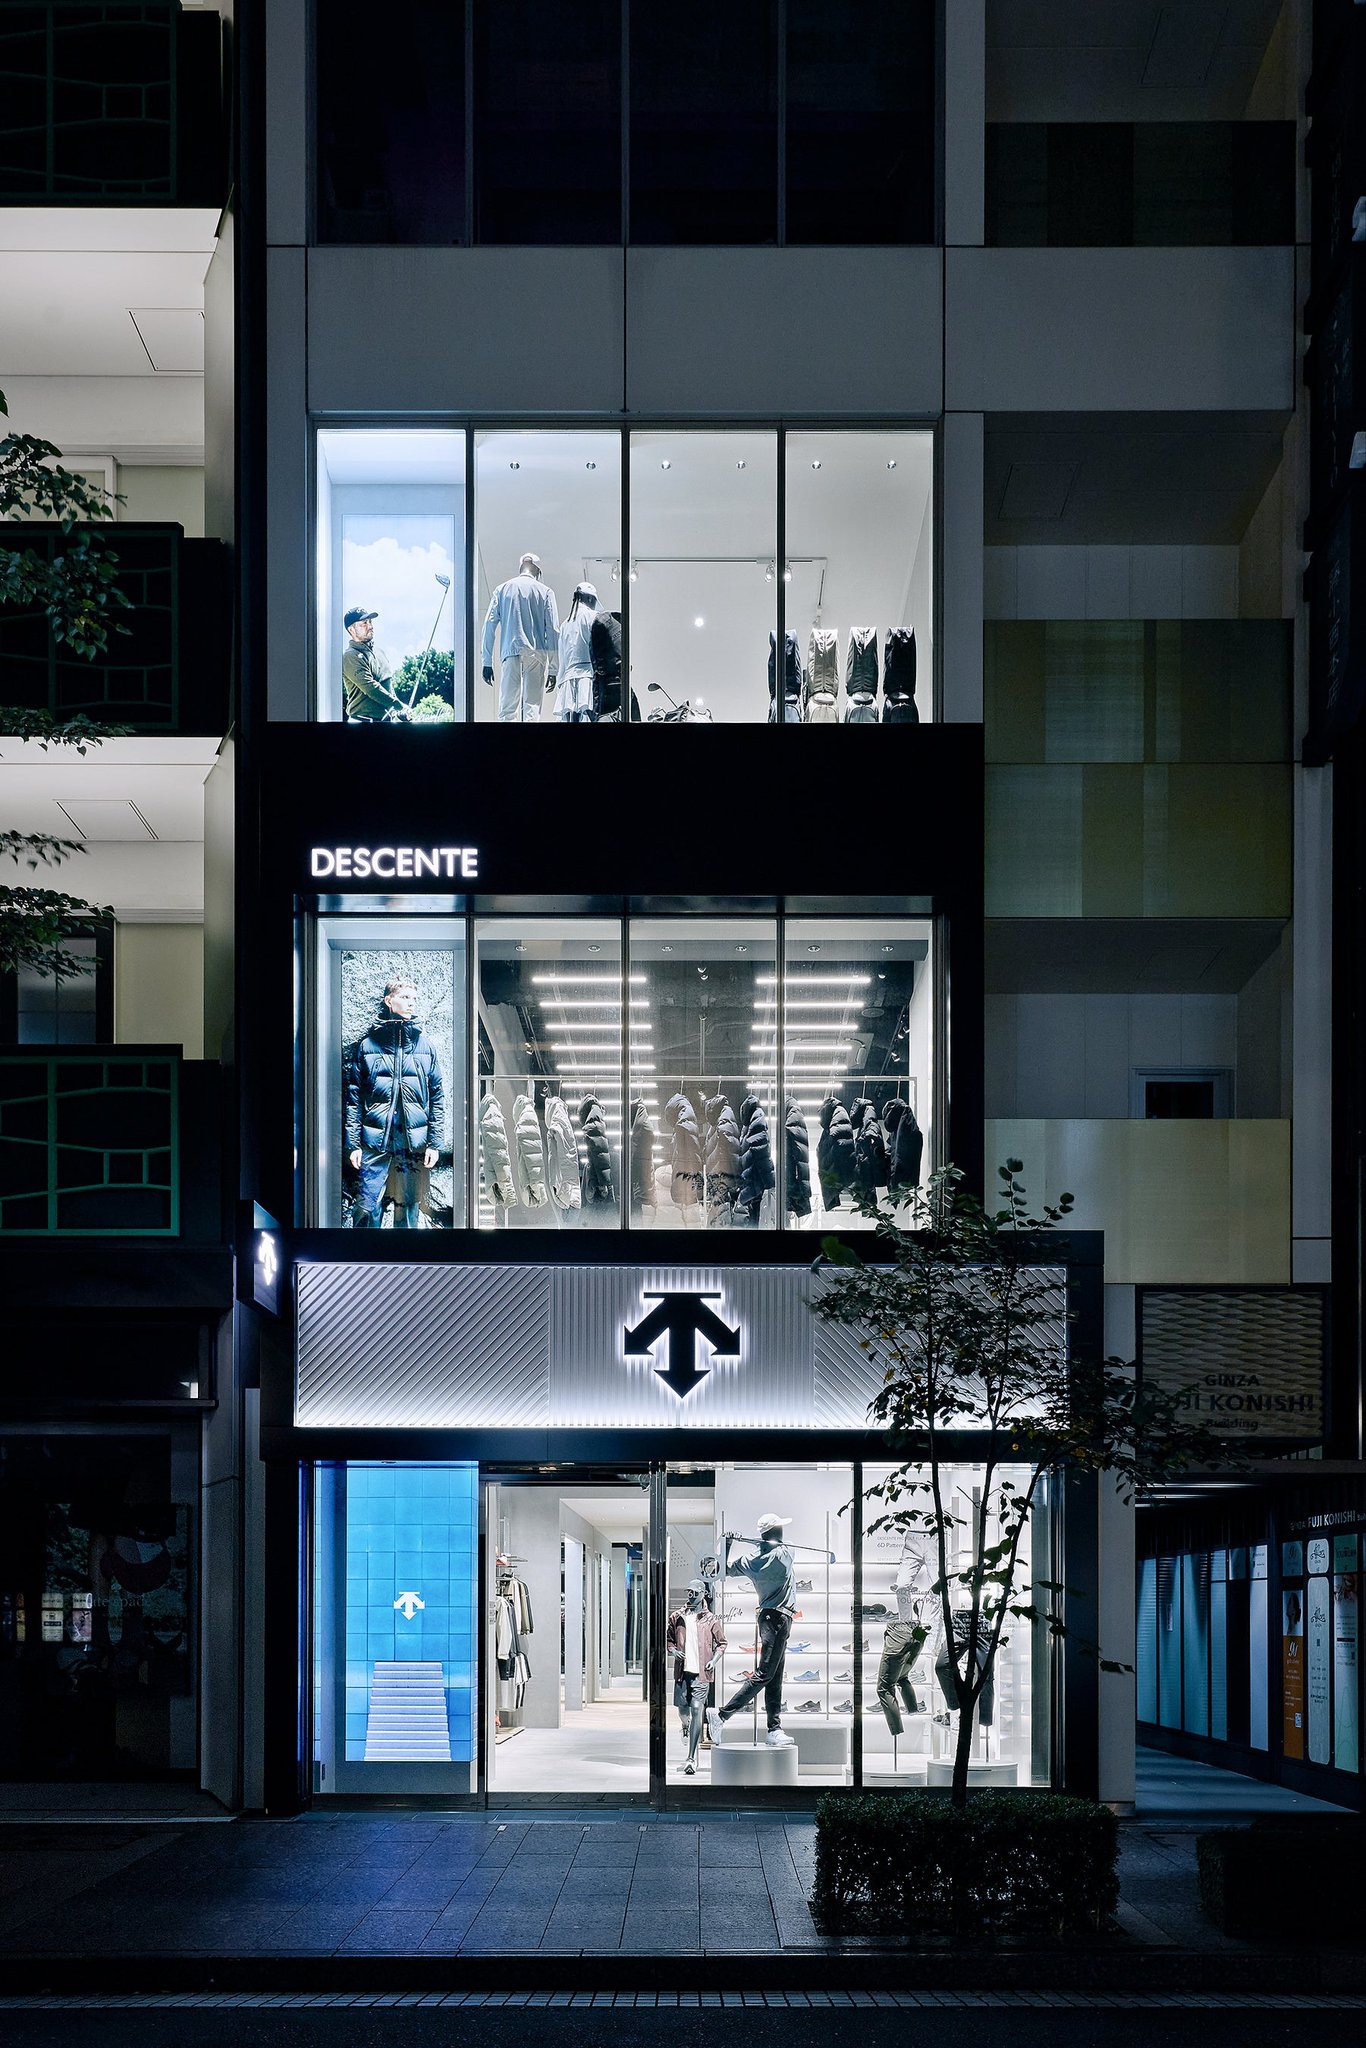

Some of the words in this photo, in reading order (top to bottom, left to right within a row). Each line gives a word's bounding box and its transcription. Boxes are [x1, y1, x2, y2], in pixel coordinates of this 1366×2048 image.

[311, 848, 478, 877] DESCENTE
[1205, 1374, 1260, 1387] GINZA
[1211, 1394, 1314, 1411] KONISHI
[1307, 1514, 1323, 1528] FUJI
[1323, 1509, 1356, 1526] KONISHI
